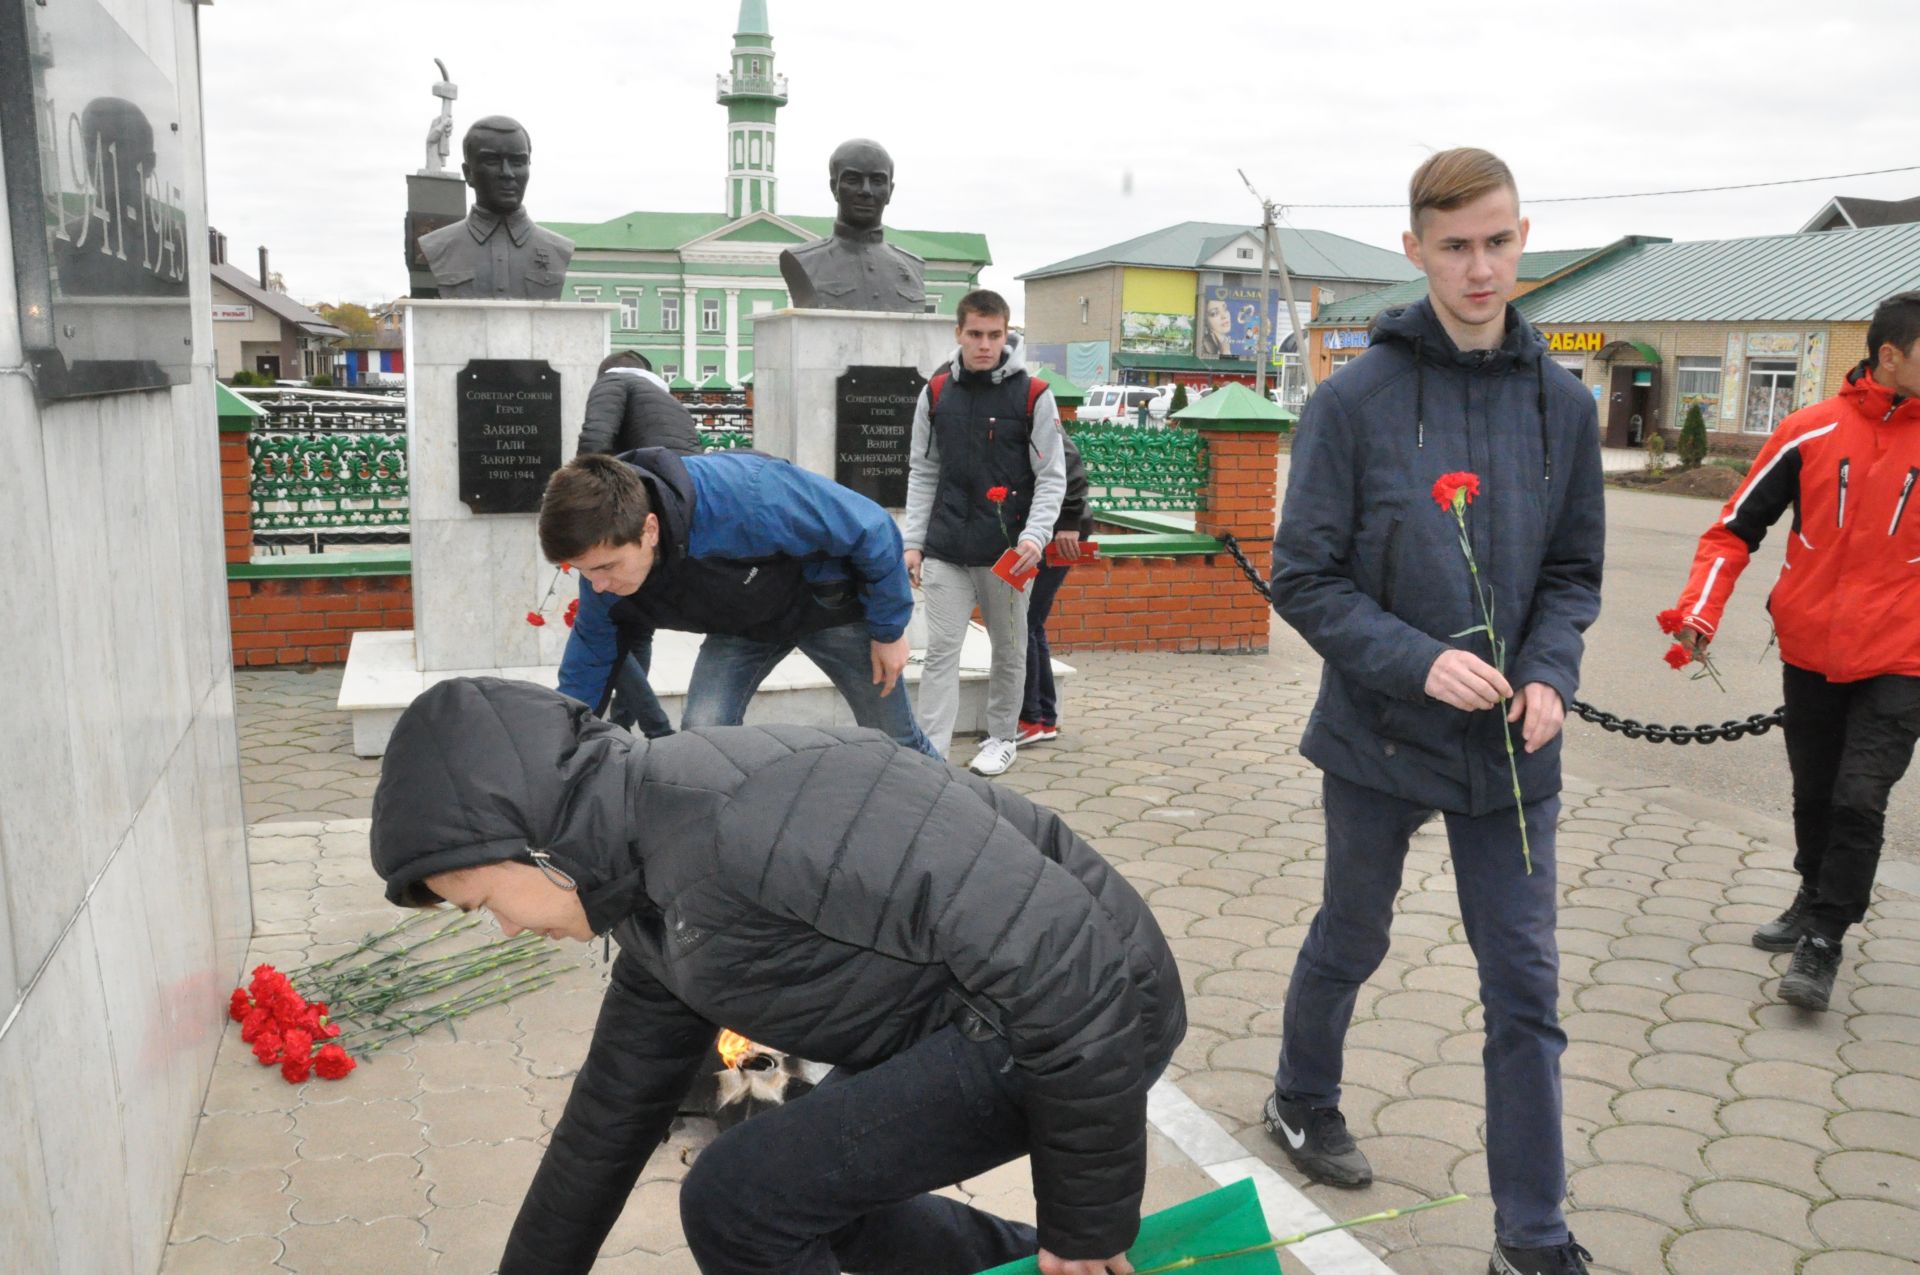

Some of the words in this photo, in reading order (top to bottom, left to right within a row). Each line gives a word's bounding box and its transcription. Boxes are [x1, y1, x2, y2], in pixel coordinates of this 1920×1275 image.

[46, 98, 185, 282] 1941-1945
[1232, 289, 1263, 299] ALMA
[482, 424, 538, 435] ЗАКИРОВ
[496, 440, 525, 450] ГАЛИ
[480, 454, 516, 465] ЗАКИР
[488, 470, 535, 480] 1910-1944
